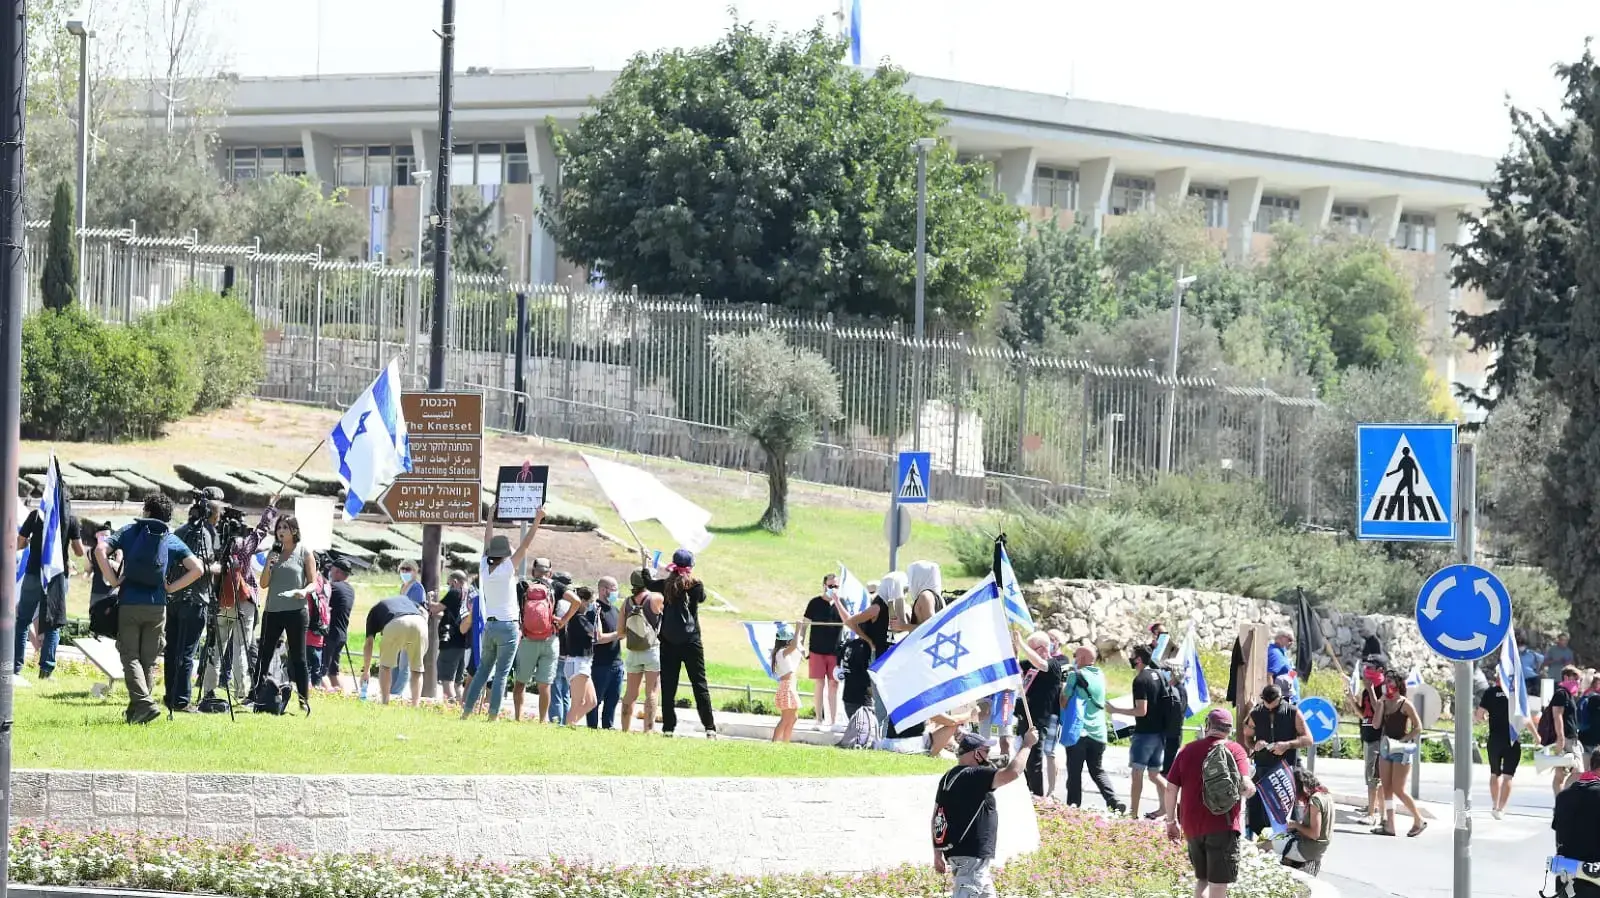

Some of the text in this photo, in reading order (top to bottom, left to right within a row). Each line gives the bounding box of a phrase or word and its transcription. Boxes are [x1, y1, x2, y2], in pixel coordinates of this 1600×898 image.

[419, 398, 457, 407] הכנסת
[427, 421, 473, 431] Knesset
[409, 440, 473, 453] התחנה לחקר ציפור
[452, 455, 471, 466] مركز
[414, 465, 447, 477] Watching
[448, 465, 476, 475] Station
[401, 484, 434, 496] לוורדים
[463, 486, 471, 498] גן
[397, 509, 475, 519] Wohl Rose Garden
